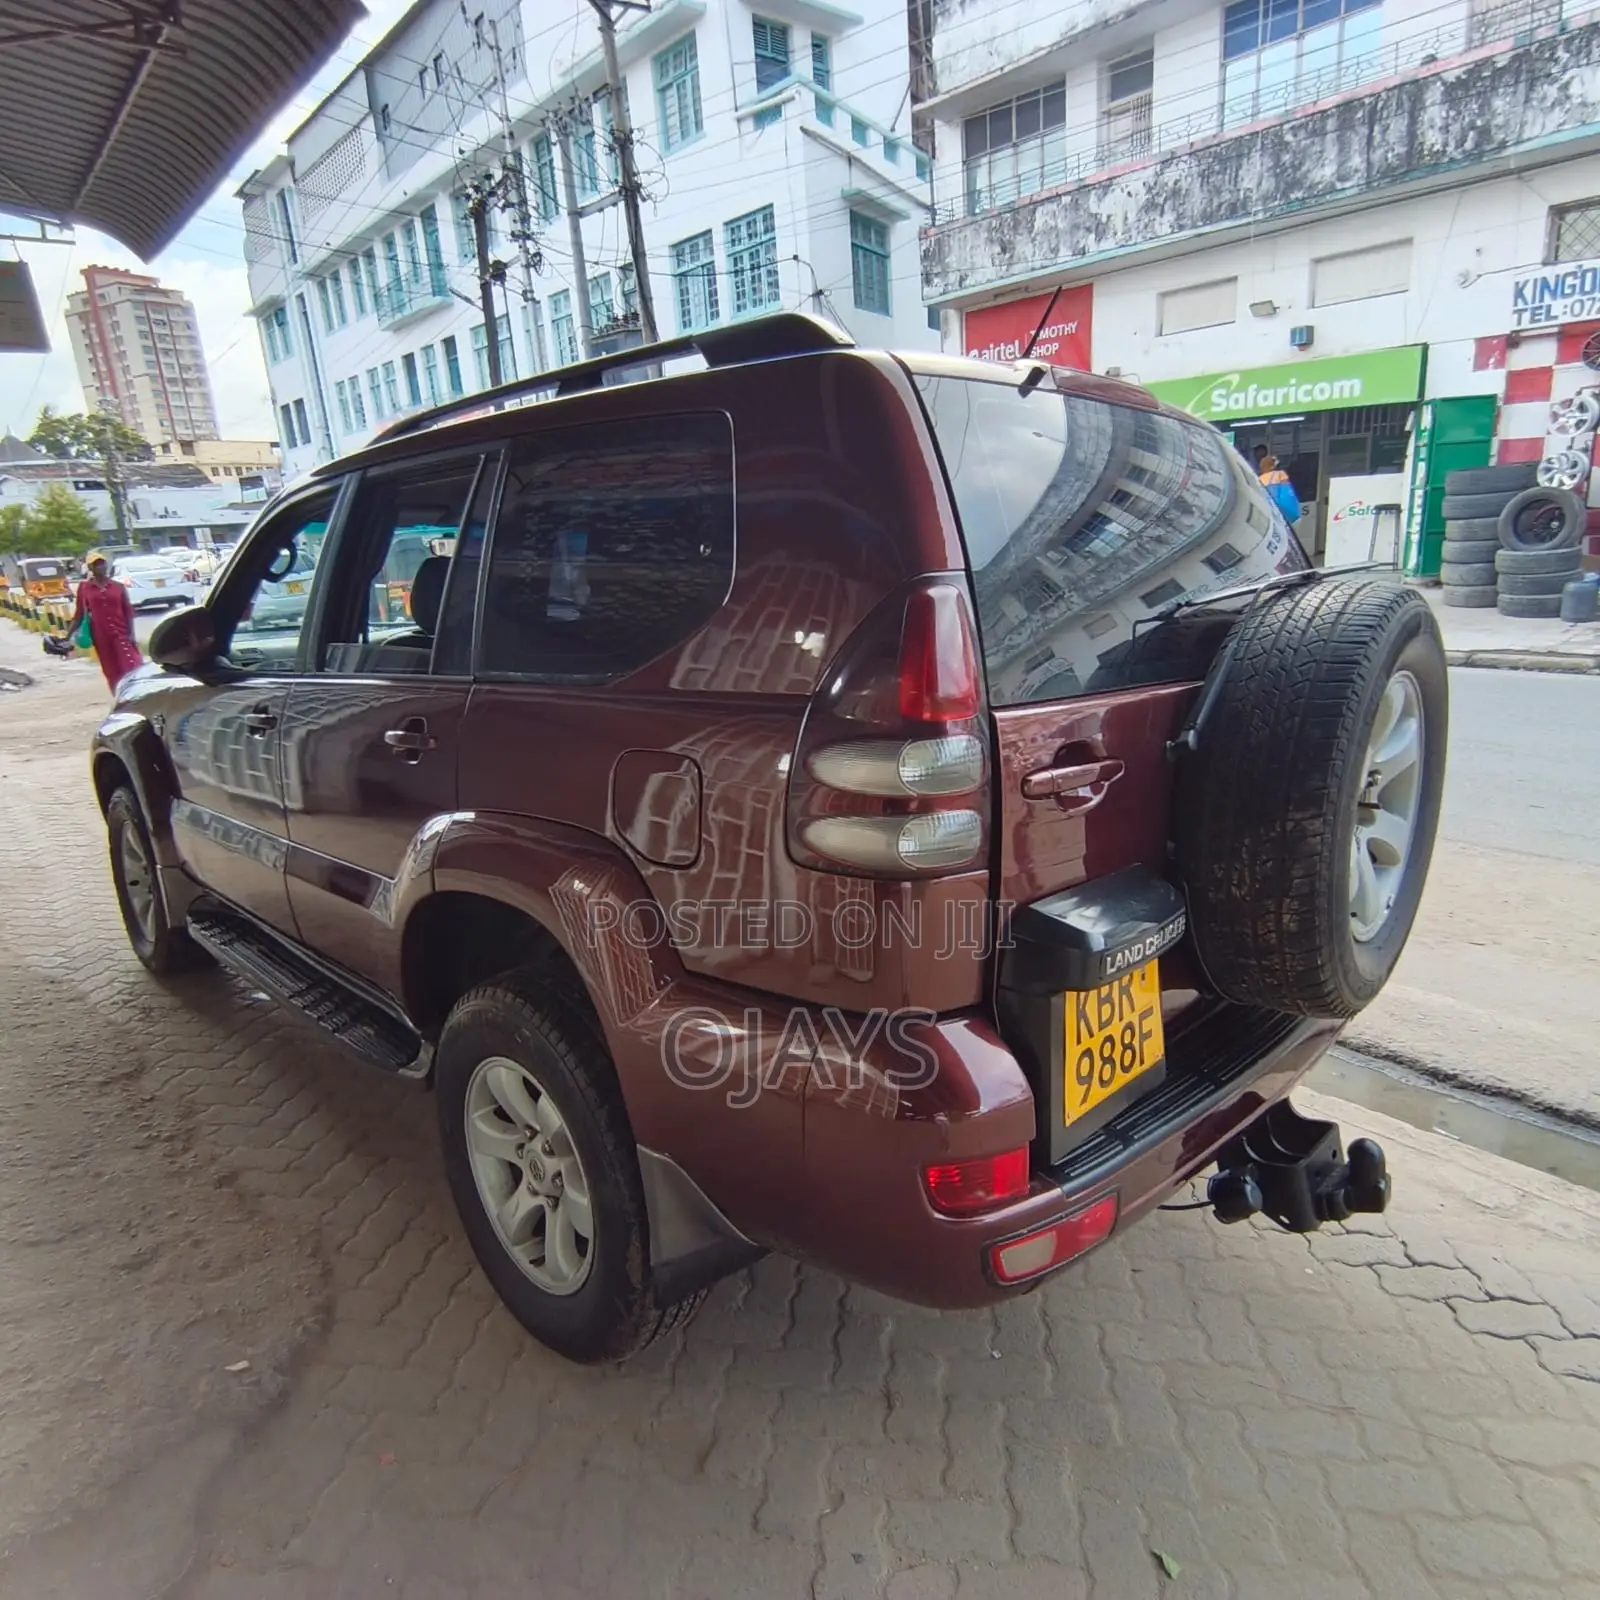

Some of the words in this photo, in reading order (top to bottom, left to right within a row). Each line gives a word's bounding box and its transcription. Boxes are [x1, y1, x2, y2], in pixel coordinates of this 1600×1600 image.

[1512, 267, 1600, 307] KINGD
[1029, 321, 1077, 340] TMOTHY
[981, 340, 1020, 361] airtel
[1030, 343, 1059, 358] SHOP
[1210, 378, 1362, 412] Safaricom
[1106, 943, 1143, 975] LAND
[1076, 971, 1135, 1046] KBR
[1076, 1006, 1154, 1106] 988F
